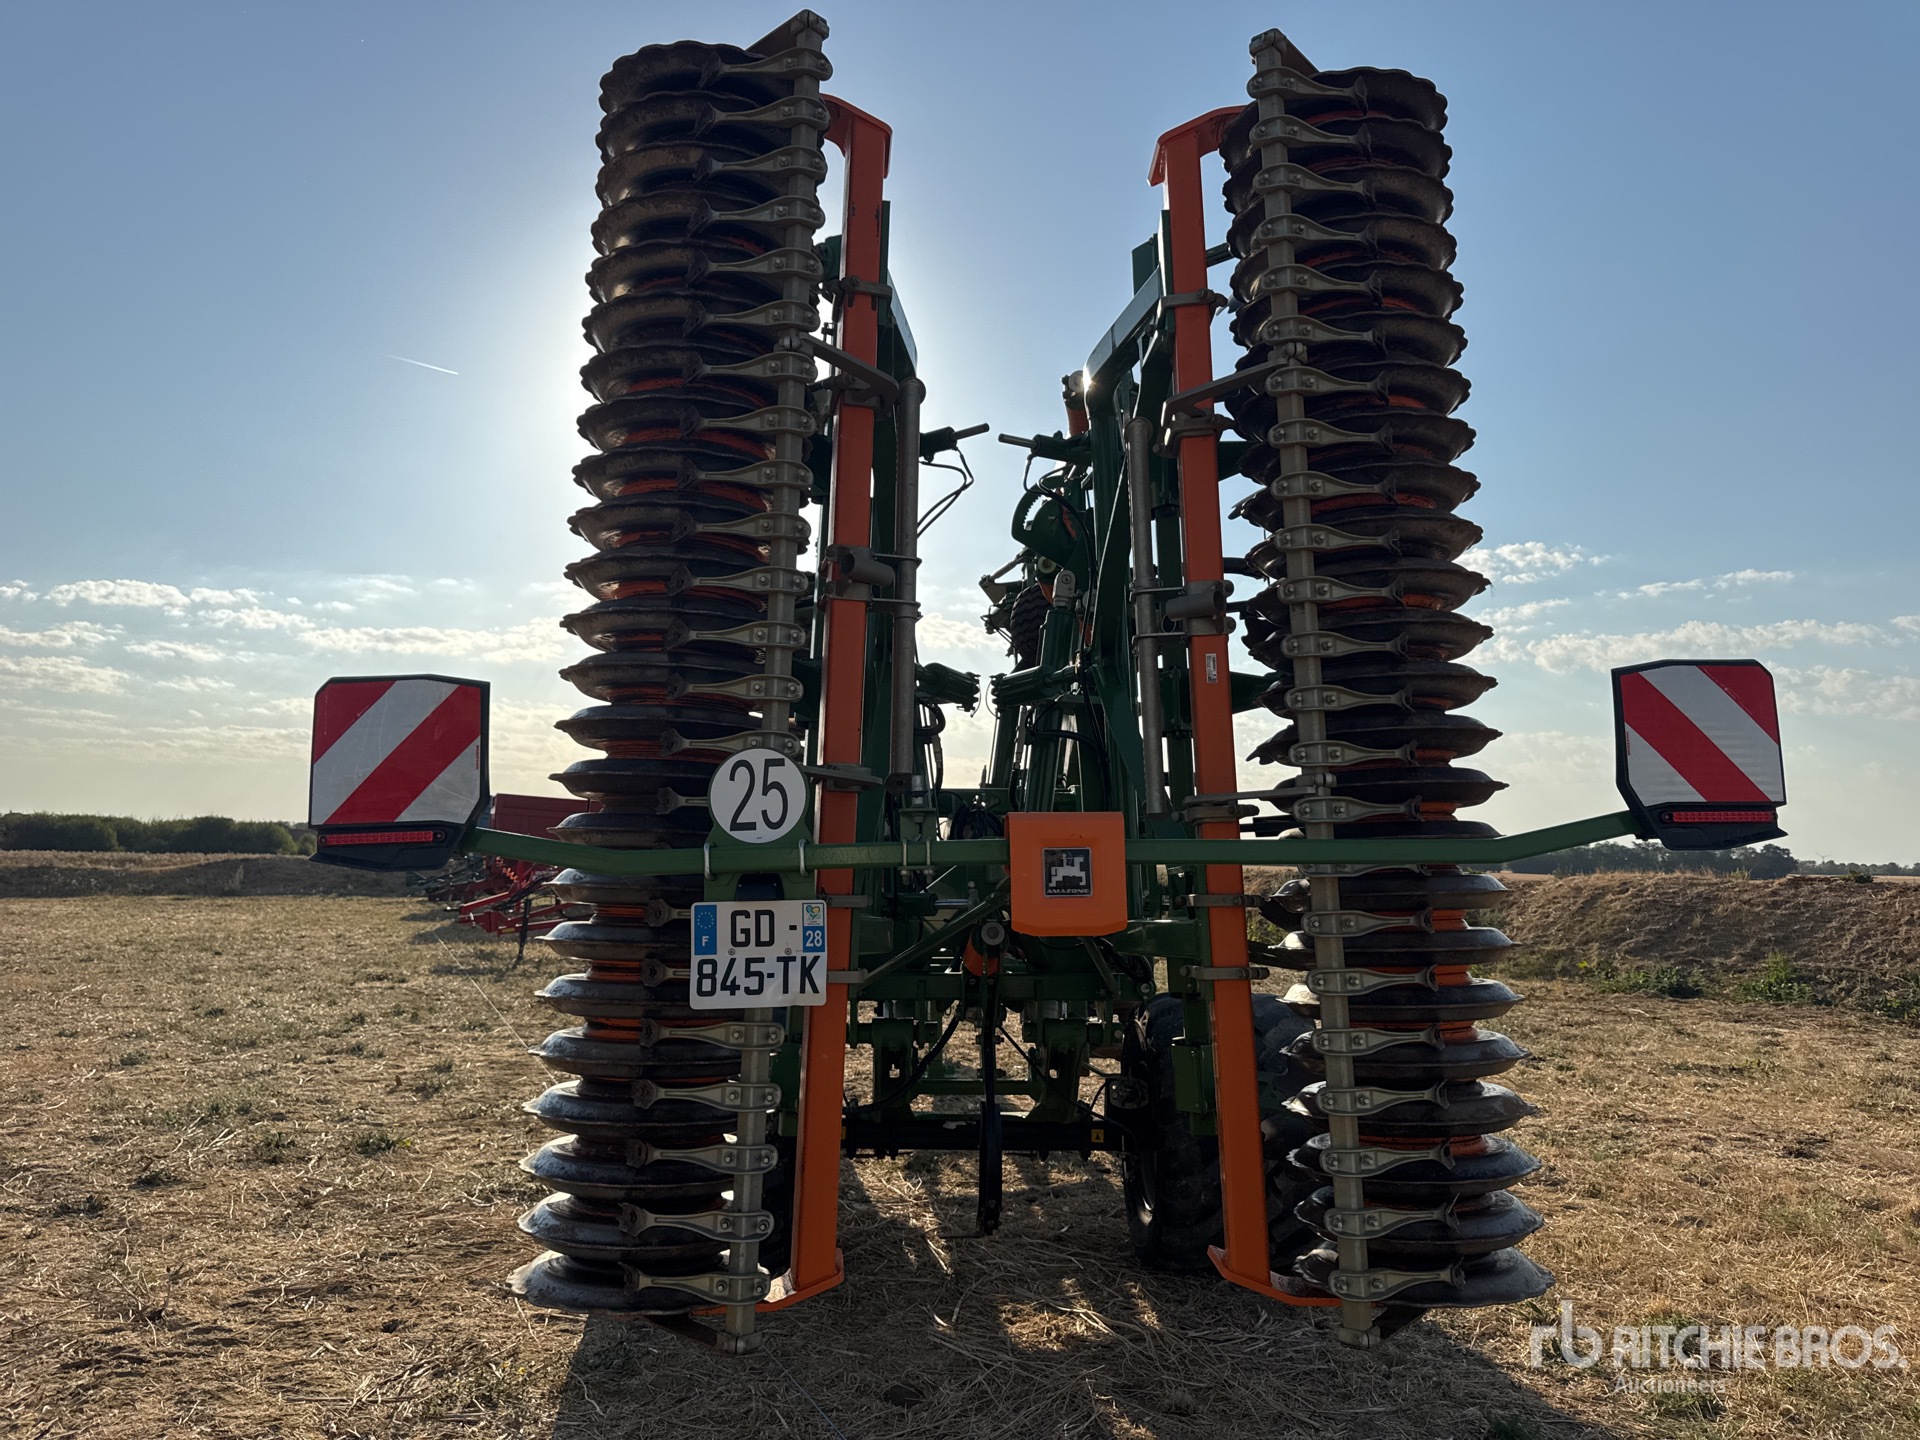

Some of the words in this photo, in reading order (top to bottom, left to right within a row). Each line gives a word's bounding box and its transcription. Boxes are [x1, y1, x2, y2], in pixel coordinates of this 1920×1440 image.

[729, 758, 788, 832] 25
[701, 936, 709, 947] F
[805, 930, 823, 948] 28
[696, 955, 820, 997] 845-TK
